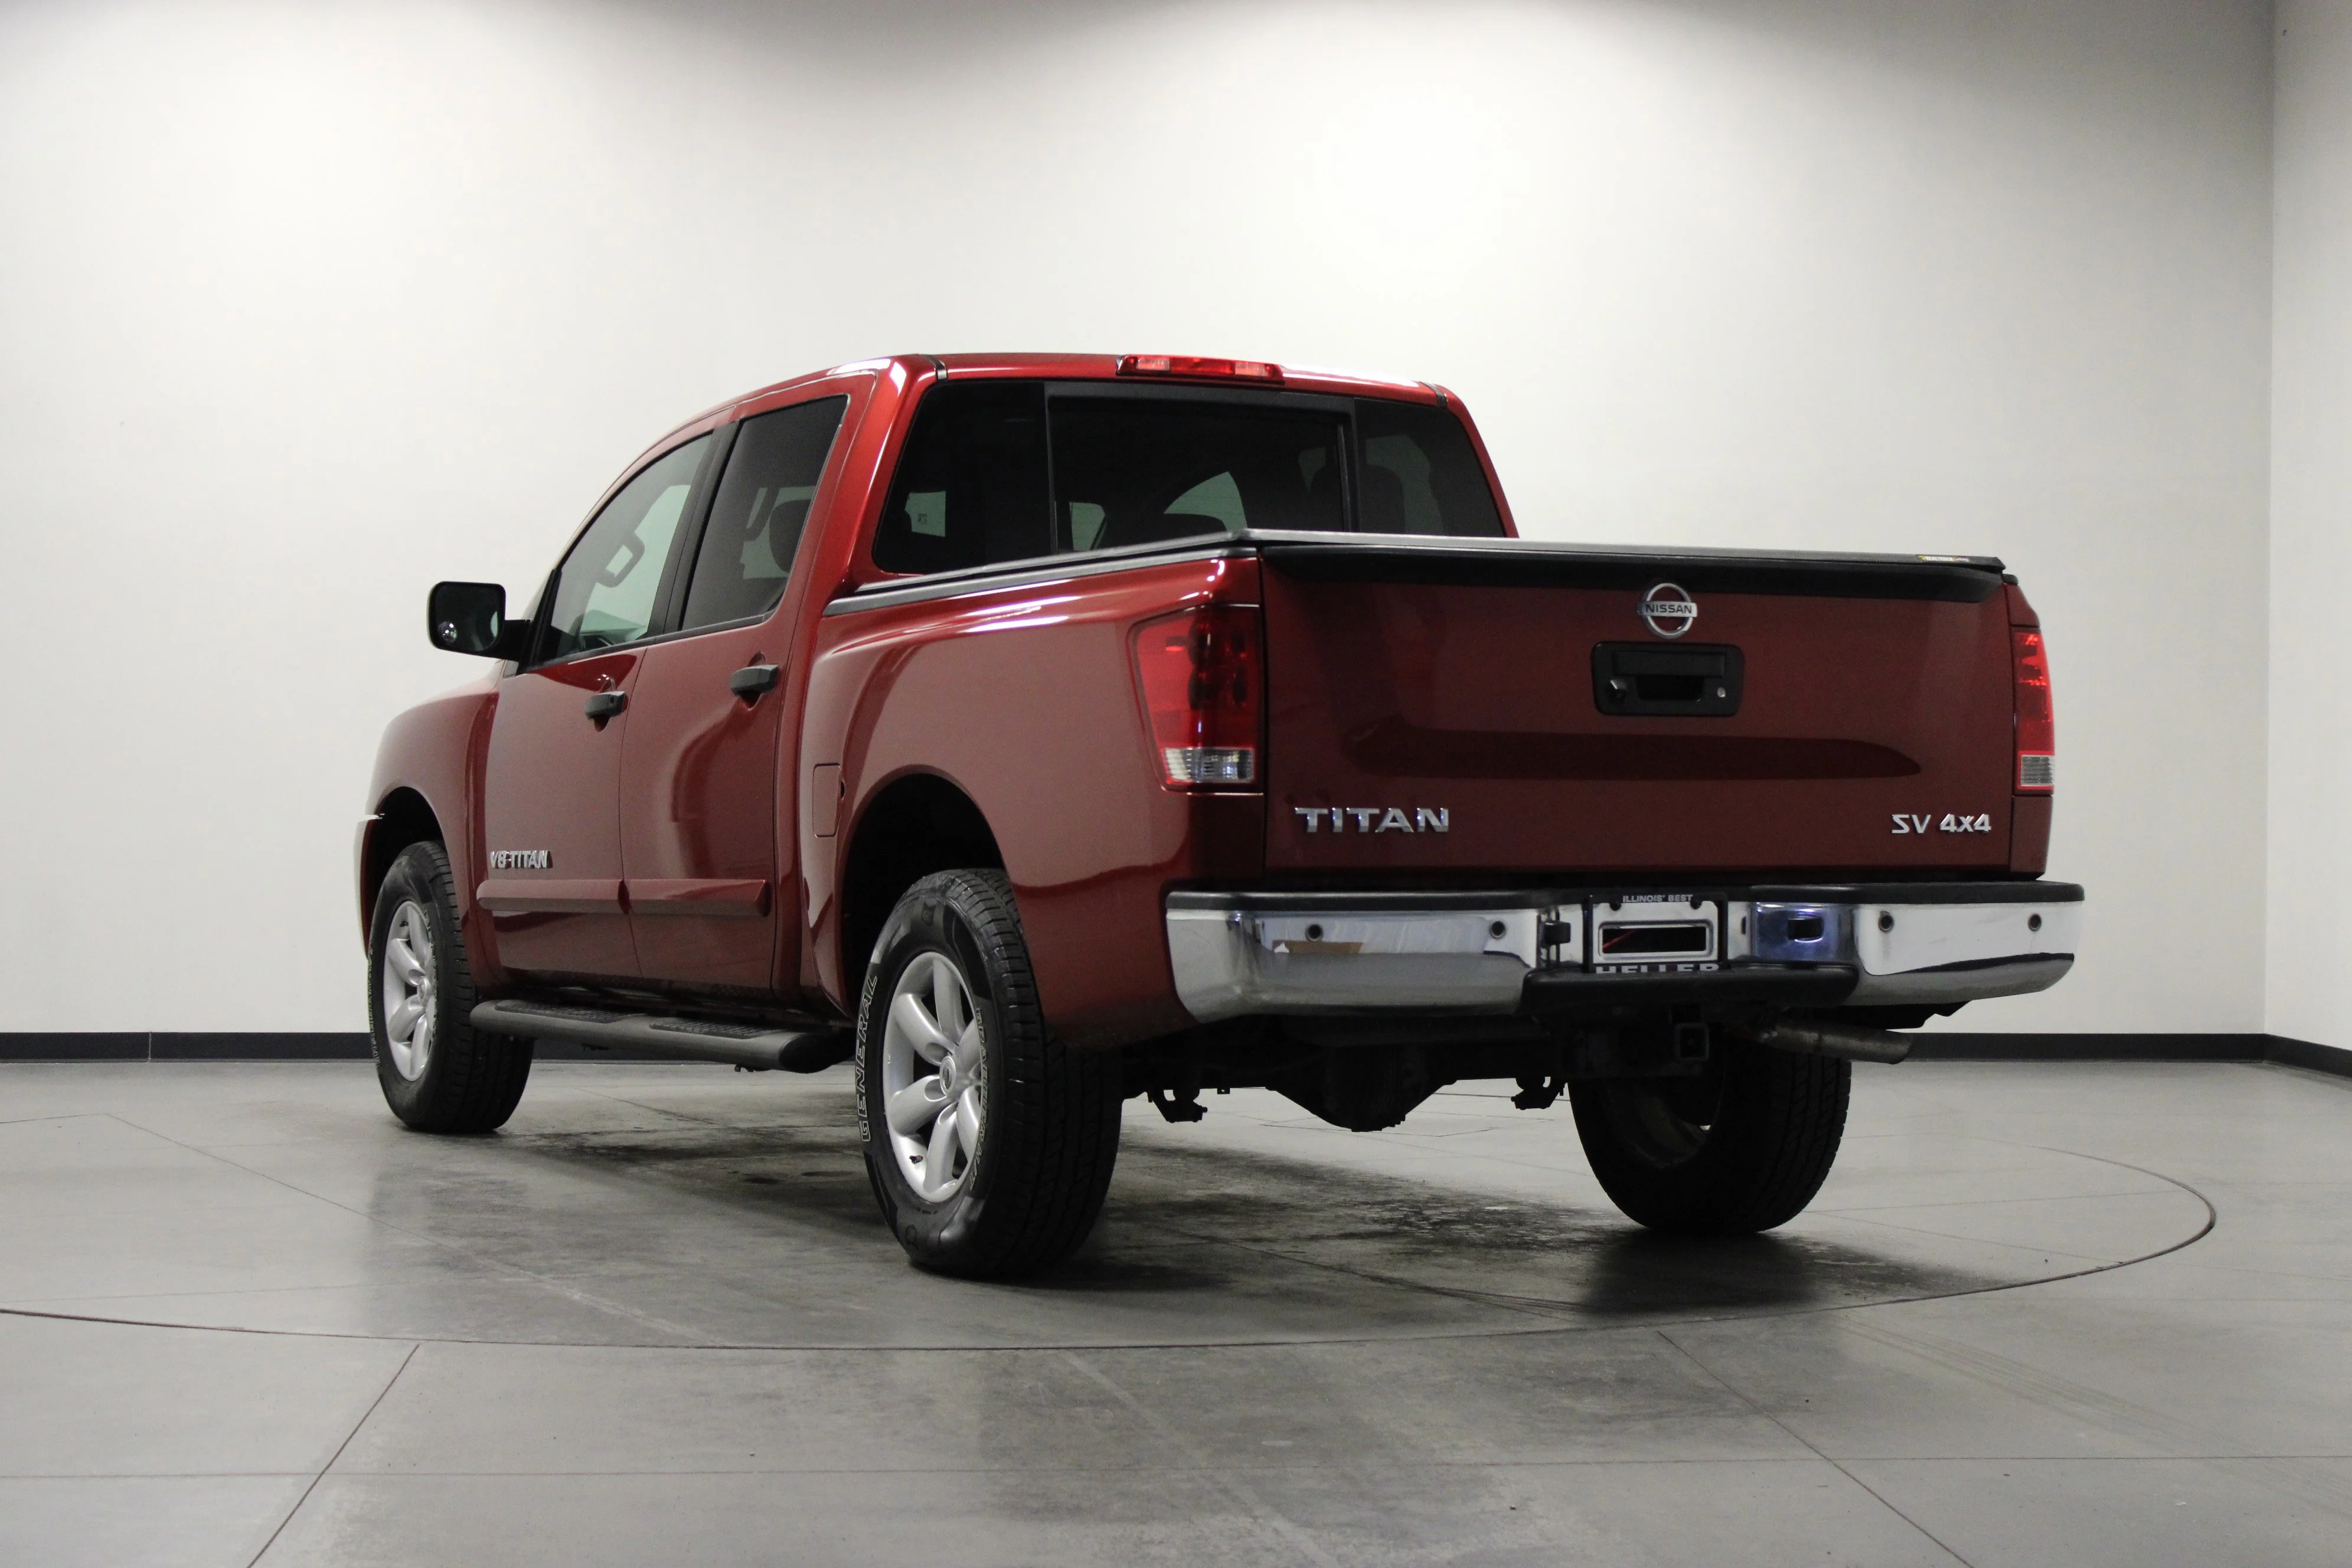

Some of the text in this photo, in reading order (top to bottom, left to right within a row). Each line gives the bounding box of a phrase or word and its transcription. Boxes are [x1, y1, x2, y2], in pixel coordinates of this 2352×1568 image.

[1645, 604, 1692, 614] NISSAN
[1295, 807, 1449, 833] TITAN
[1892, 813, 1992, 834] SV 4x4
[508, 850, 550, 868] TITAN
[856, 975, 877, 1142] GENERAL
